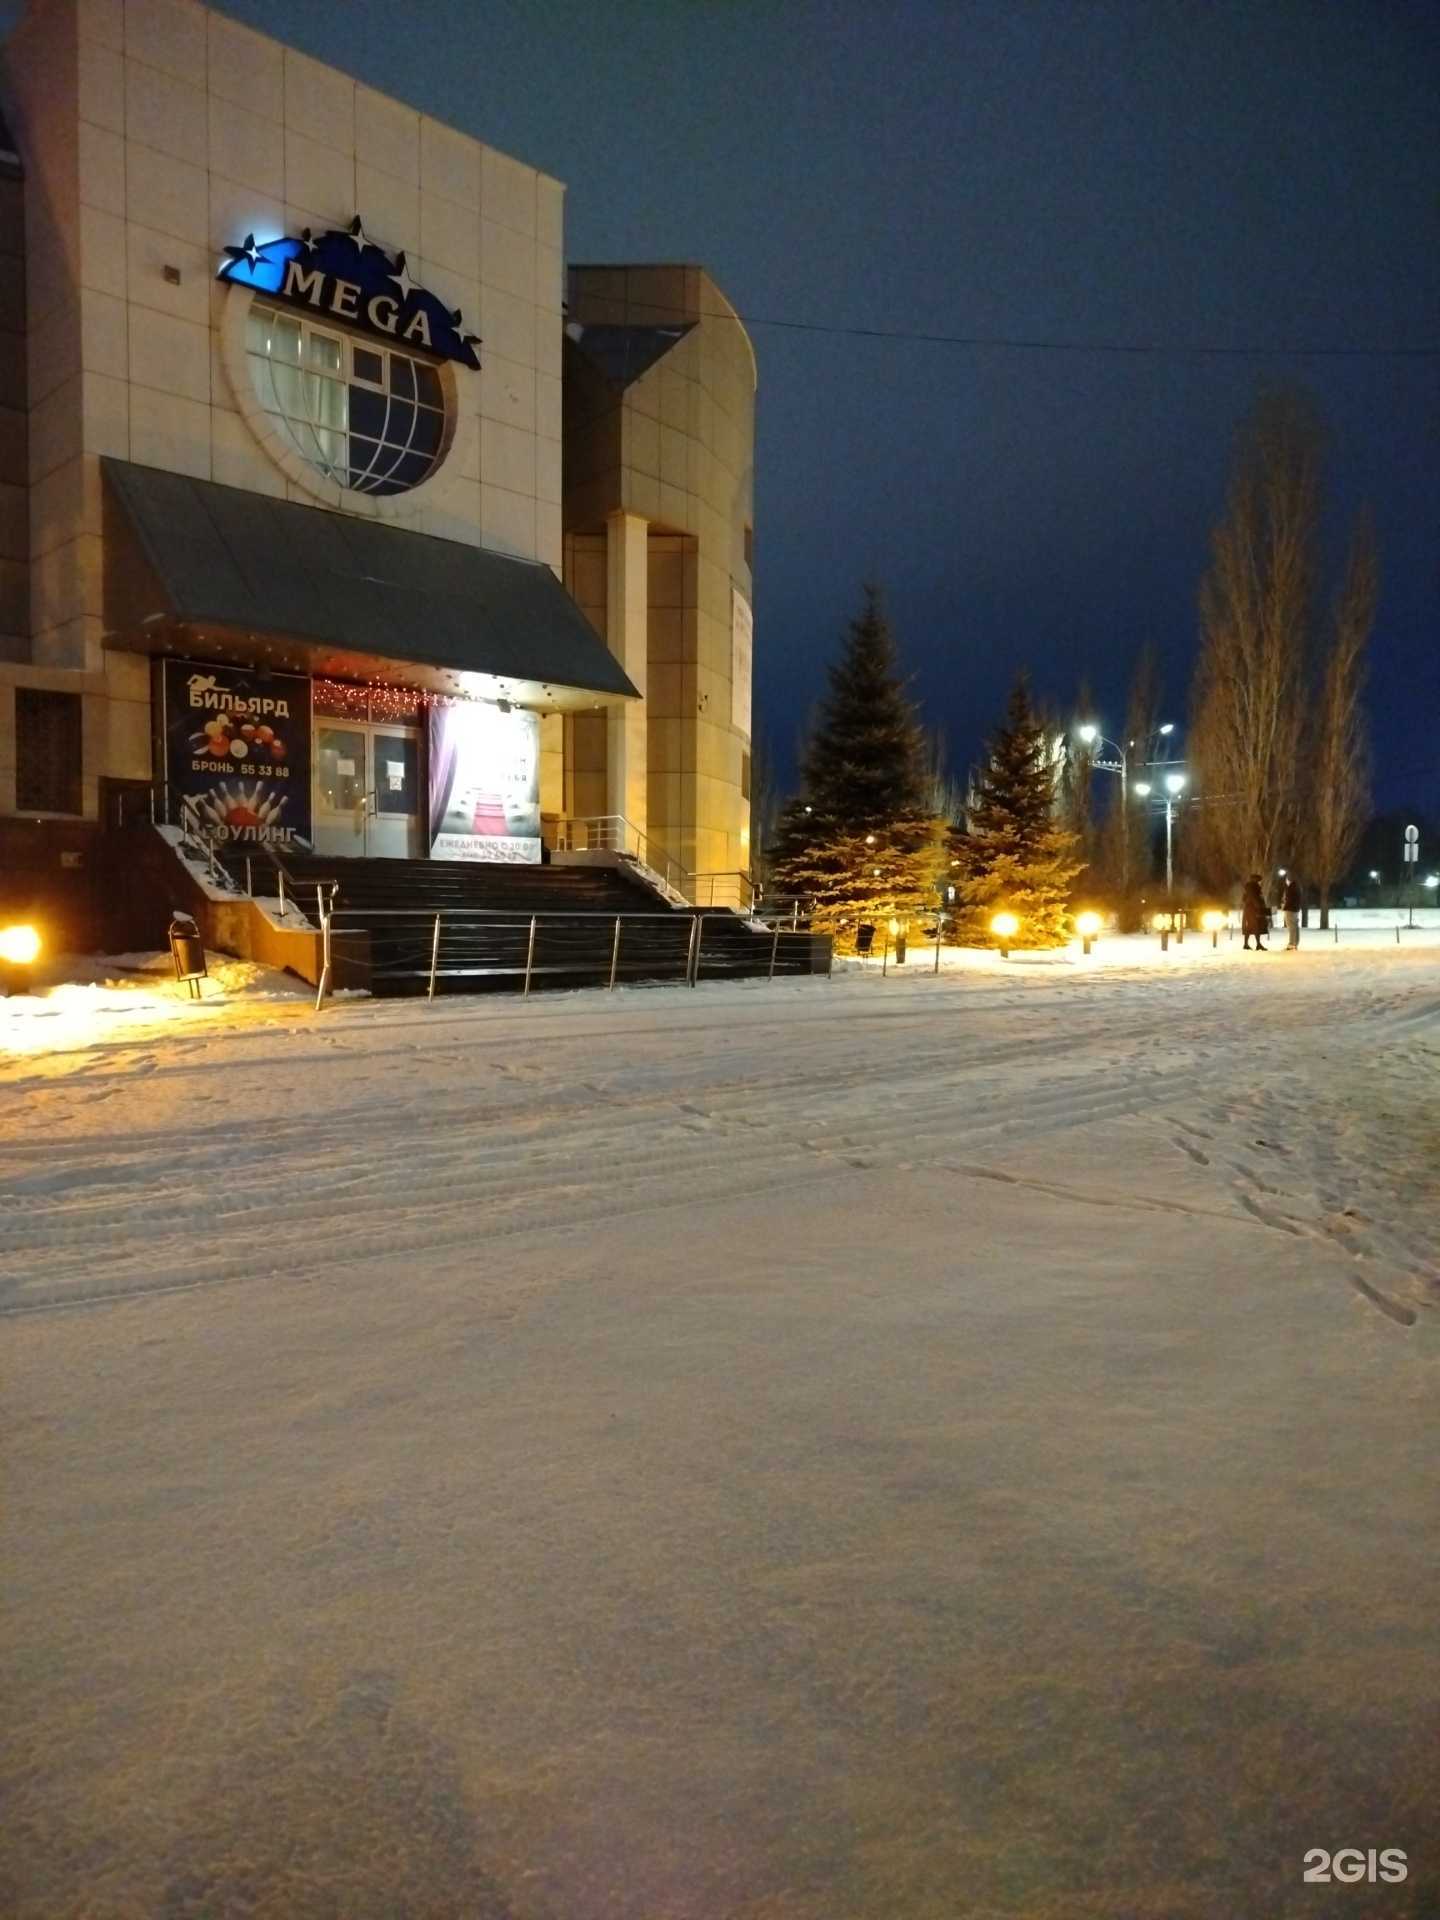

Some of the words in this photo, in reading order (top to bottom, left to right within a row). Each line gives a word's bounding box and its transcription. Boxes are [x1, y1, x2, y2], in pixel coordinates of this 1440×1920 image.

[283, 260, 432, 346] MEGA
[189, 690, 290, 719] БИЛЬЯРД
[192, 760, 234, 774] БРОНЬ
[241, 764, 255, 775] 55
[258, 765, 272, 777] 33
[275, 767, 289, 778] 88
